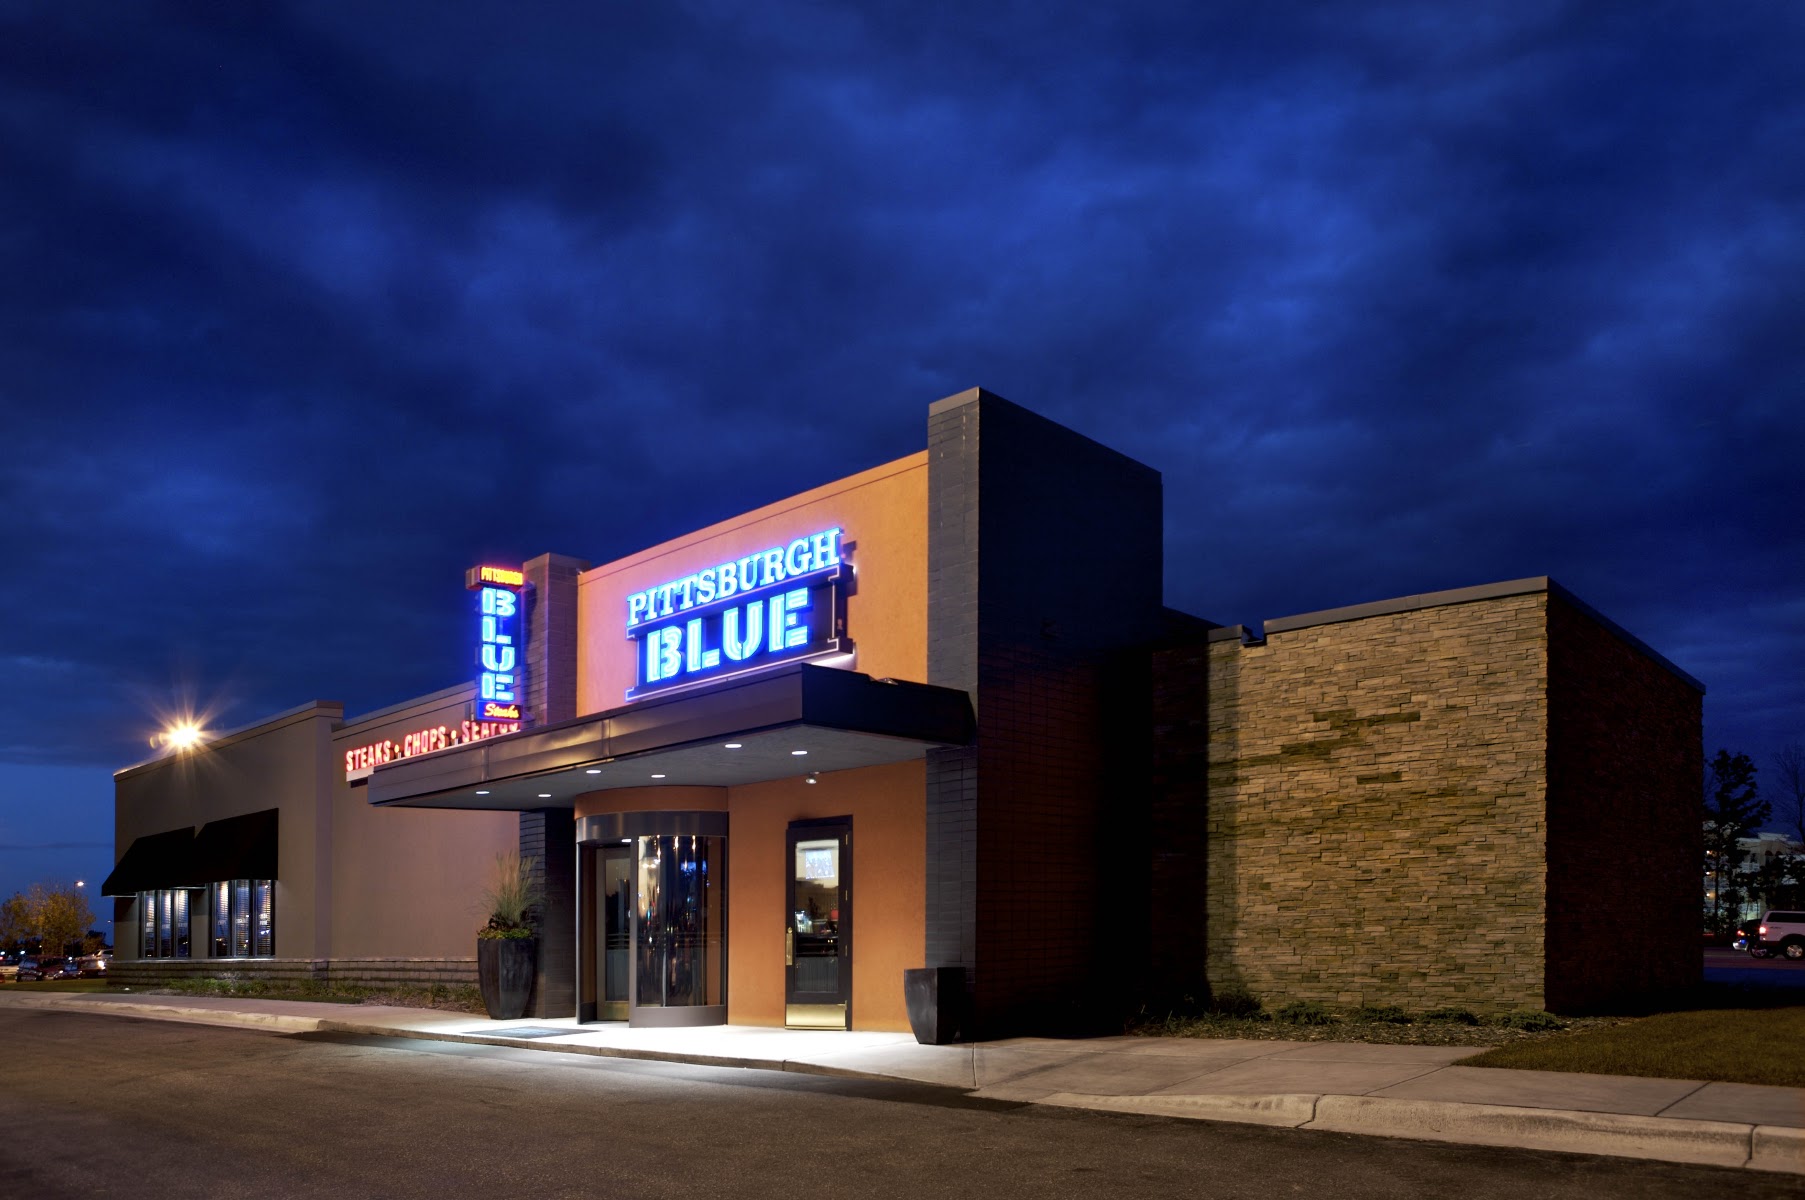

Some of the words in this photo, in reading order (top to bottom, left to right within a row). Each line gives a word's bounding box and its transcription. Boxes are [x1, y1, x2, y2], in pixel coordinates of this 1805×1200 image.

[626, 527, 841, 627] PITTSBURGH
[482, 587, 516, 701] BLUE
[646, 587, 808, 683] BLUE
[345, 740, 392, 772] STEAKS
[403, 726, 446, 757] CHOPS
